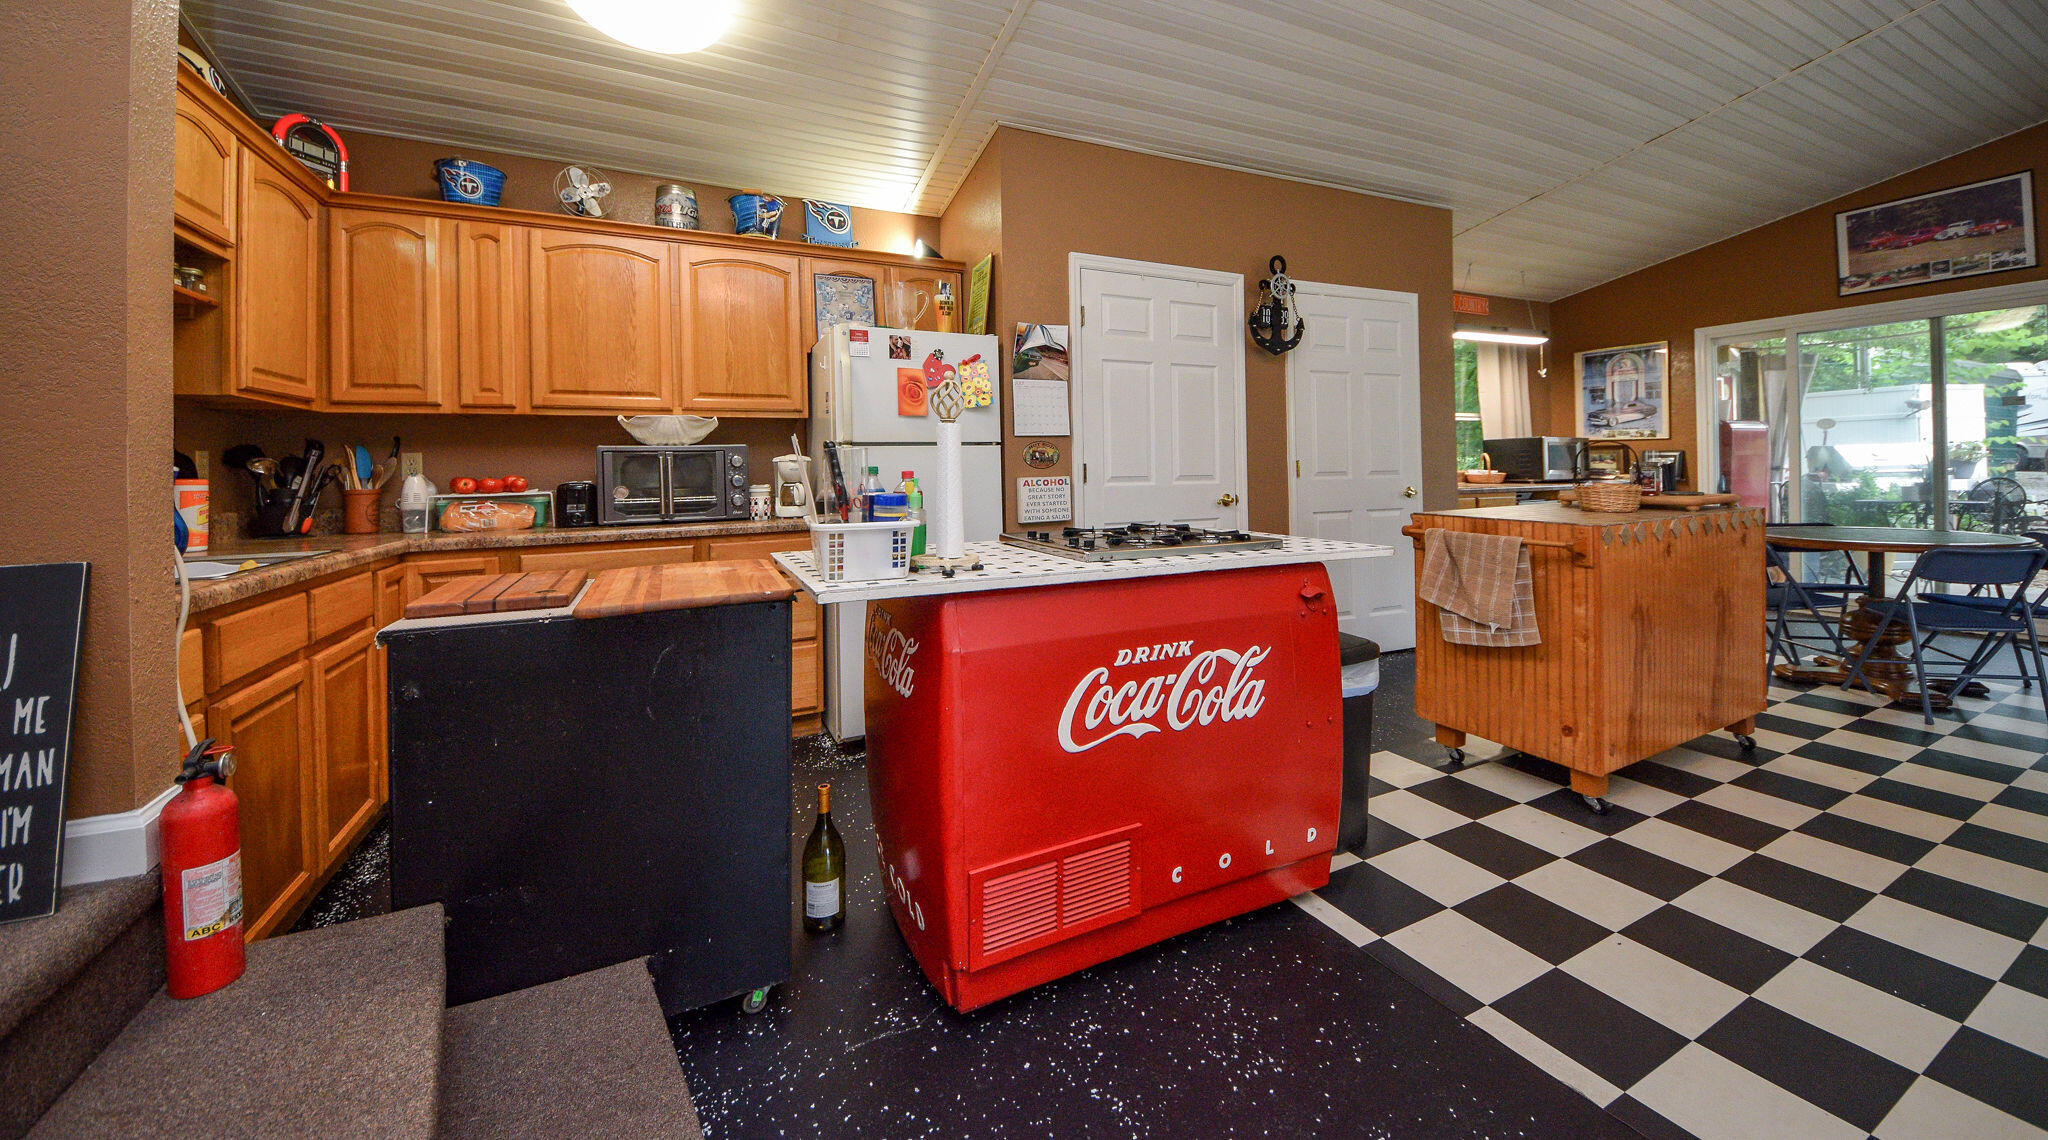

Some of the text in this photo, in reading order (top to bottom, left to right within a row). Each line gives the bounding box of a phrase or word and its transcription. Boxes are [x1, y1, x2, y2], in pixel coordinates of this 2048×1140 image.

[1023, 478, 1069, 487] ALCOHOL
[1113, 640, 1195, 667] DRINK
[13, 695, 51, 735] ME
[1057, 645, 1272, 753] Coca-Cola
[889, 864, 926, 932] COLD
[191, 923, 221, 938] ABC
